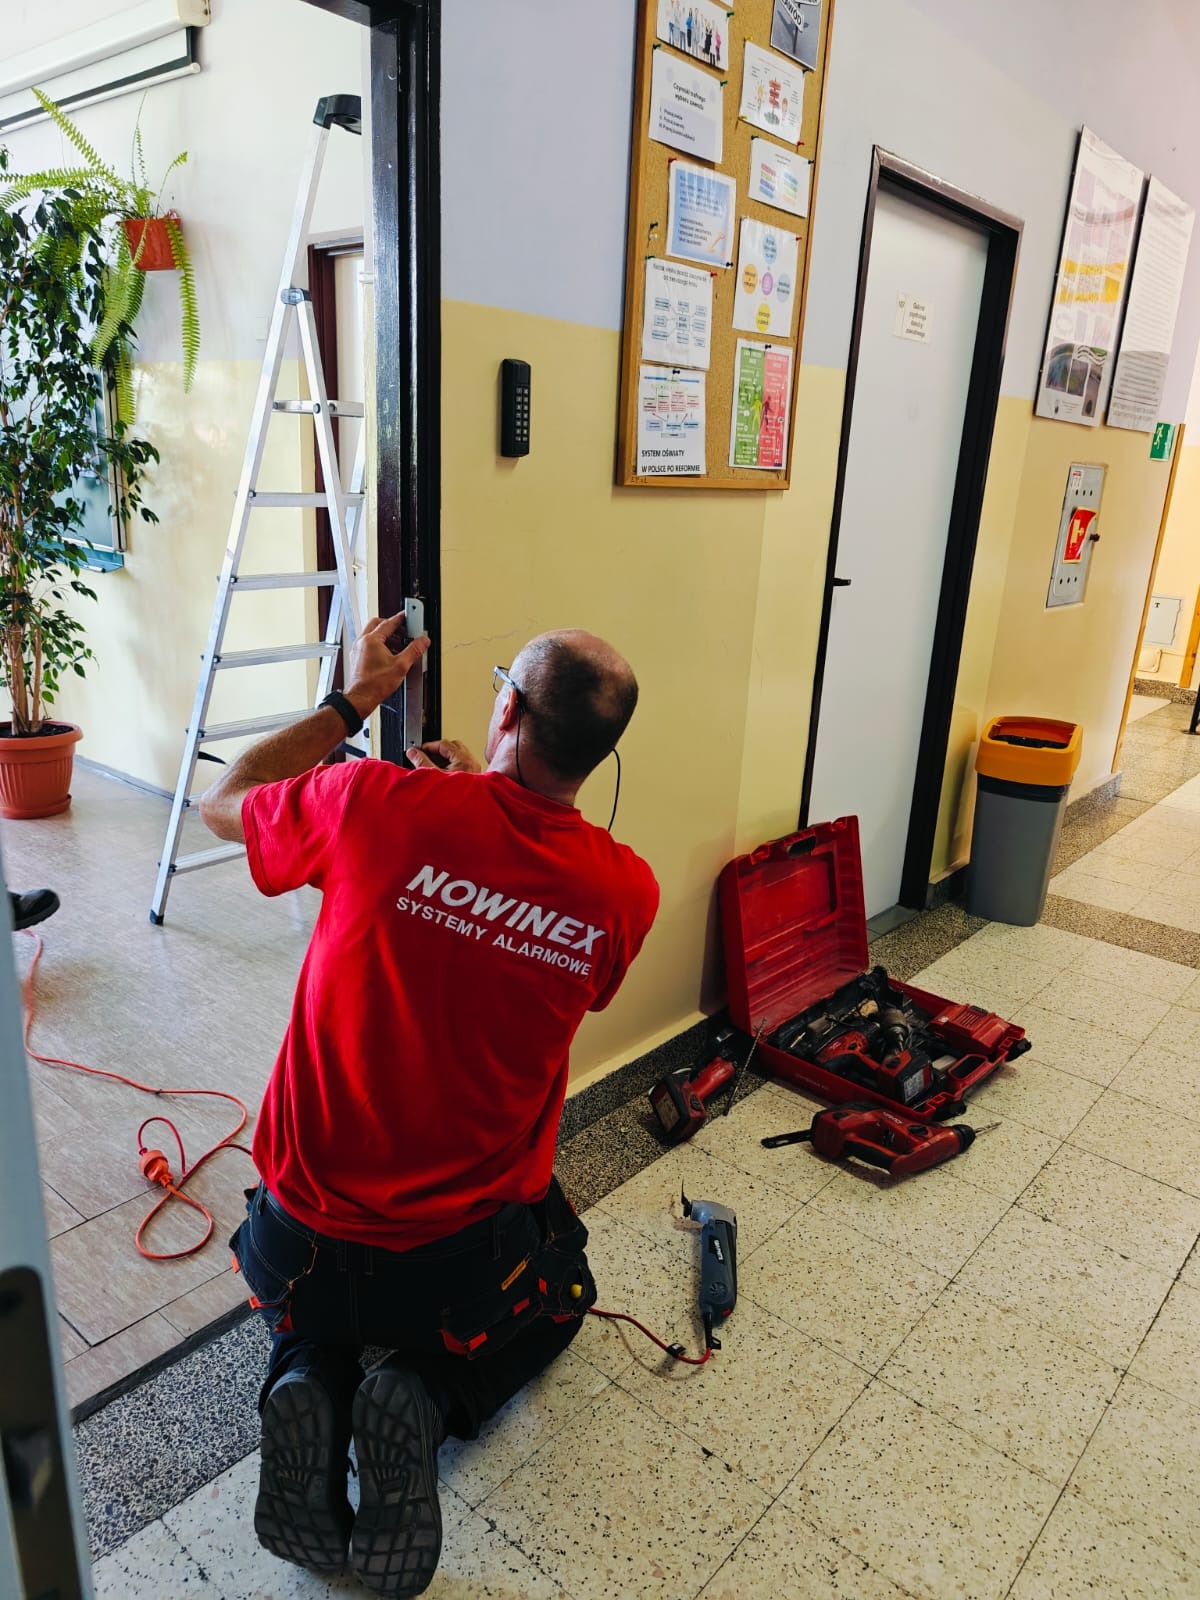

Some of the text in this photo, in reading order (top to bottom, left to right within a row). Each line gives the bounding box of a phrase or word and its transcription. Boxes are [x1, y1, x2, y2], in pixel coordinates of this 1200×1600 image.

[641, 448, 685, 457] SYSTEM OŚWIATY
[641, 464, 701, 473] W POLSCE PO REFORMIE
[406, 865, 606, 955] NOWINEX
[396, 897, 592, 976] SYSTEMY ALARMOWE
